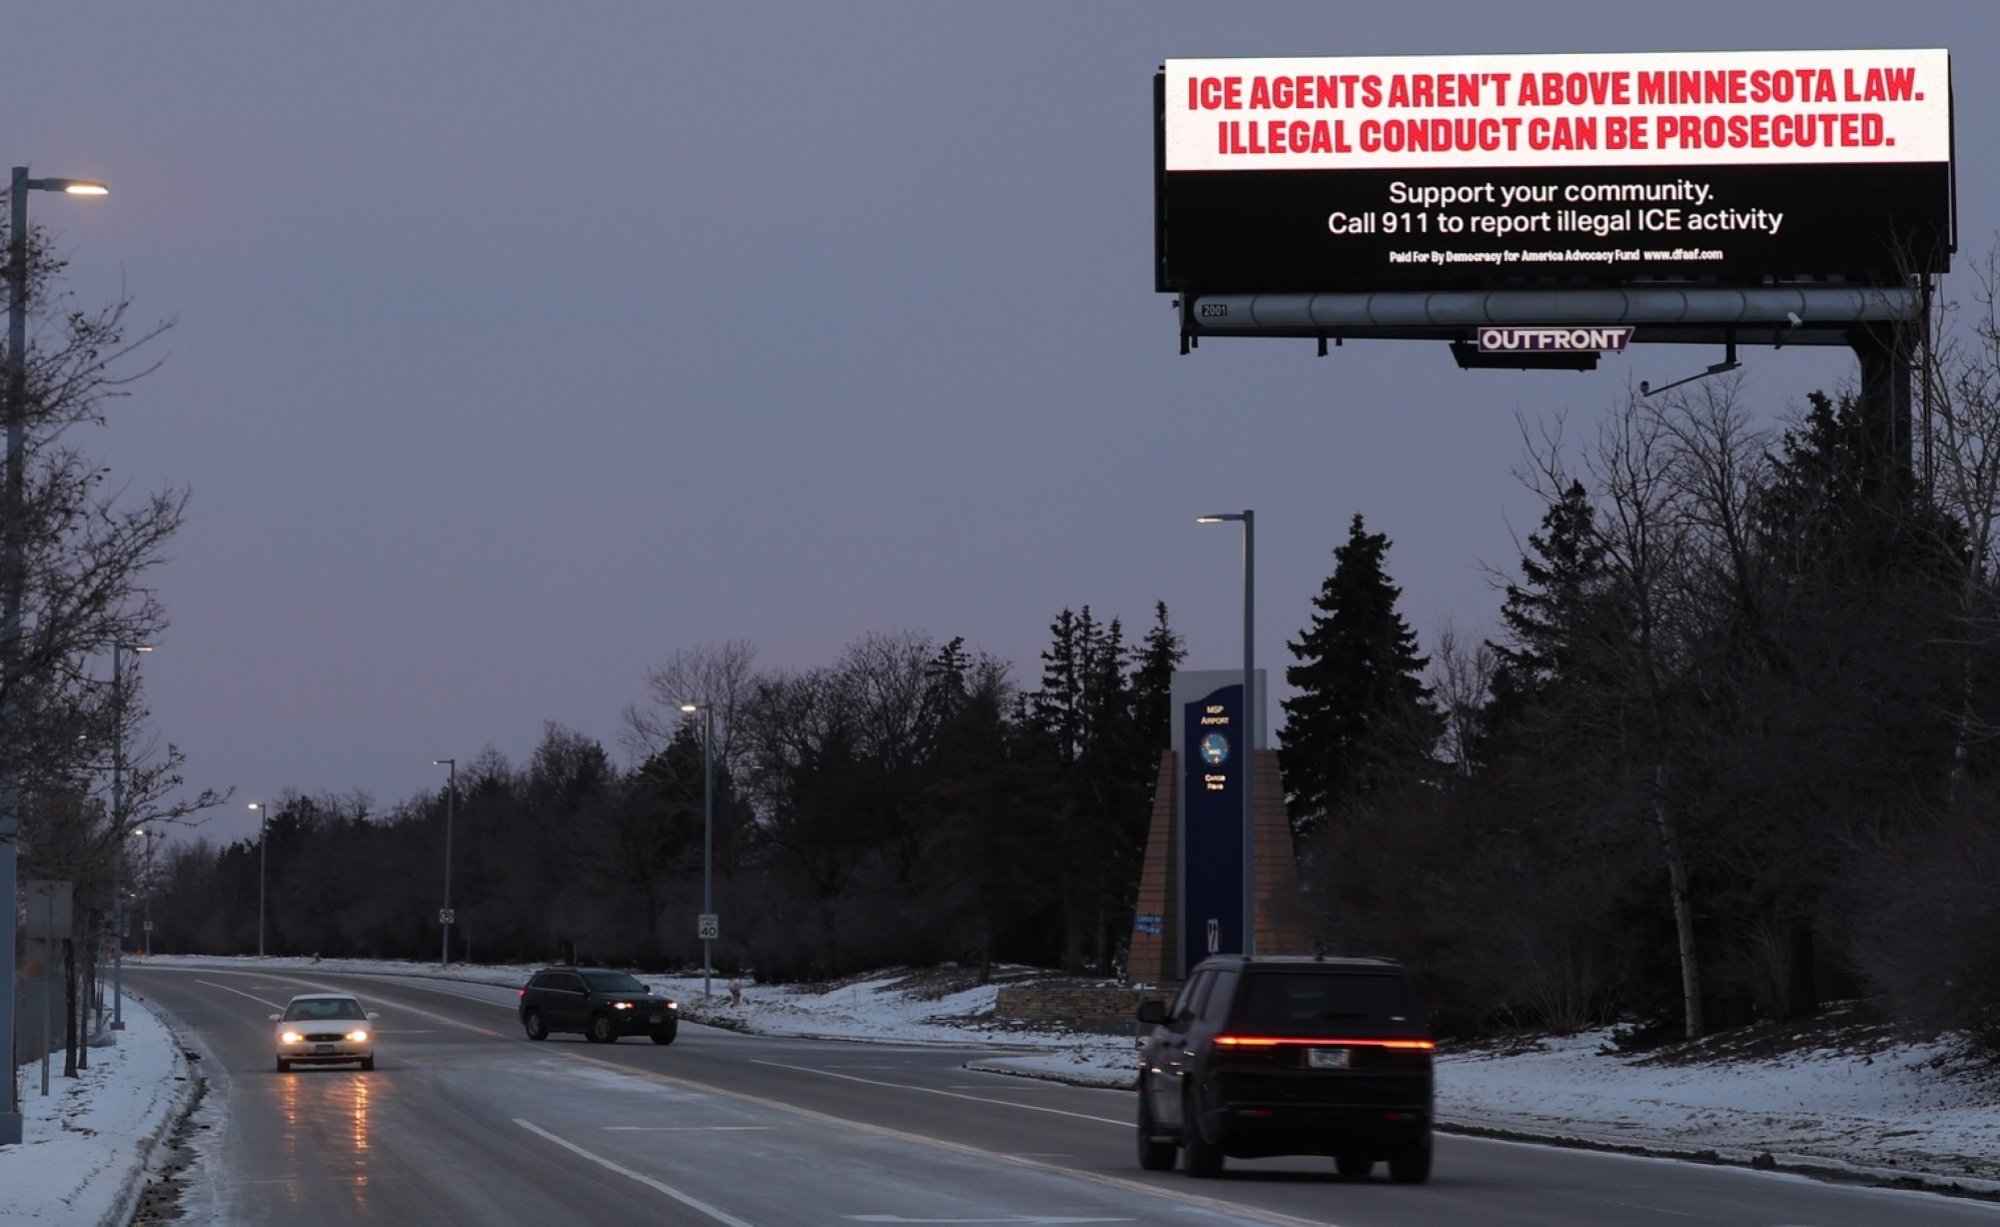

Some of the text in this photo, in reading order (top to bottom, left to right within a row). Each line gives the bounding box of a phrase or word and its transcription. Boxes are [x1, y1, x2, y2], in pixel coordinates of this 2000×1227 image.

[1188, 67, 1924, 111] ICE AGENTS AREN'T ABOVE MINNESOTA LAW.
[1218, 112, 1896, 155] ILLEGAL CONDUCT CAN BE PROSECUTED.
[1389, 178, 1714, 208] Support your community.
[1328, 207, 1784, 238] Call 911 to report illegal ICE activity
[1389, 248, 1724, 266] Paid For By Democracy for America Advocacy Fund www.dfaaf.com
[1204, 305, 1226, 316] 2001
[1482, 329, 1628, 349] OUTFRONT
[1207, 705, 1224, 714] MSP
[701, 927, 717, 937] 40
